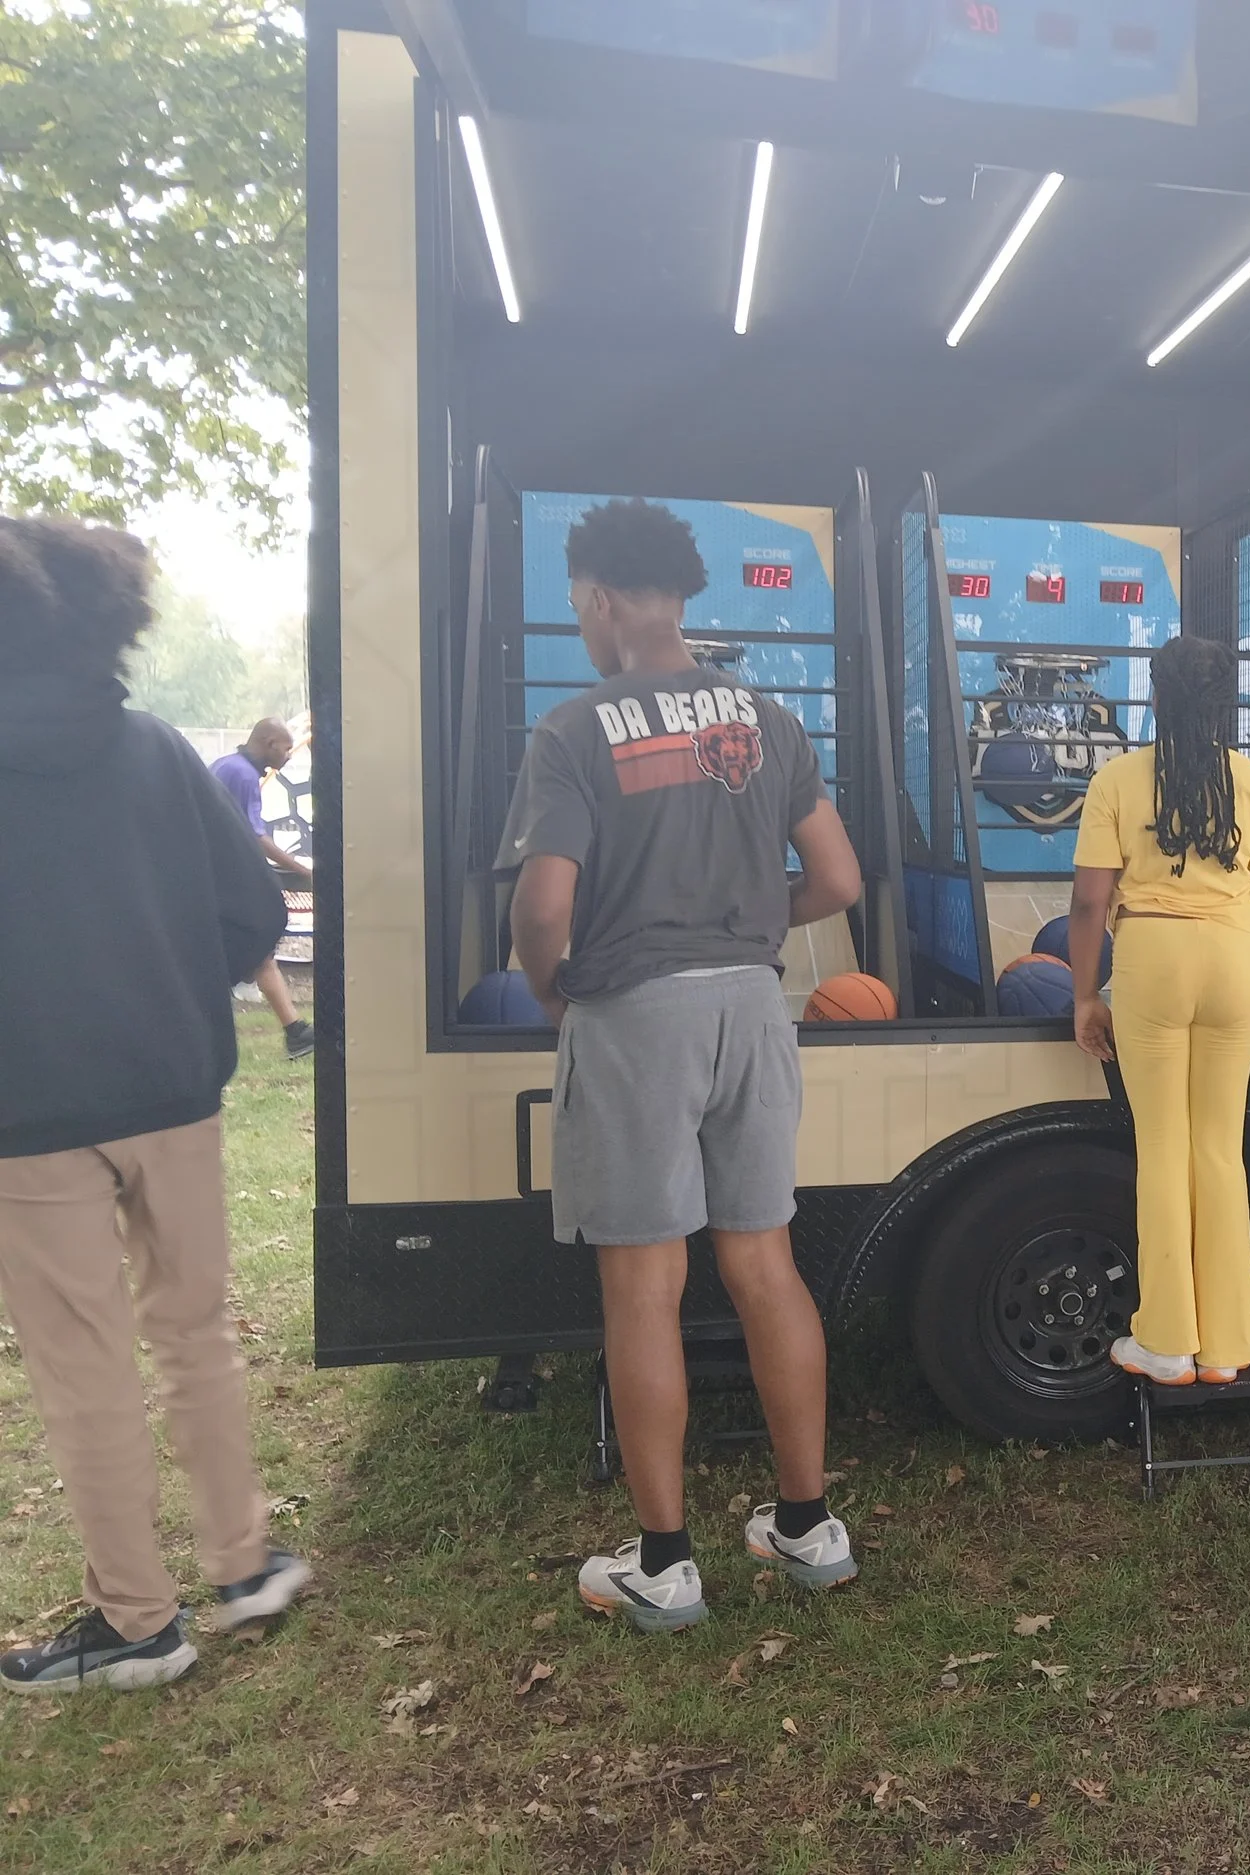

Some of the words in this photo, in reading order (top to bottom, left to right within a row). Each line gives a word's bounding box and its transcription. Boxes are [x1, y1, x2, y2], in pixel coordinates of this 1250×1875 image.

[743, 547, 791, 560] SCORE
[753, 567, 791, 588] 102
[1101, 566, 1144, 577] SCORE
[961, 576, 989, 597] 30
[1048, 577, 1063, 602] 9
[1122, 584, 1143, 602] 11
[595, 697, 652, 745] DA
[654, 686, 759, 734] BEARS
